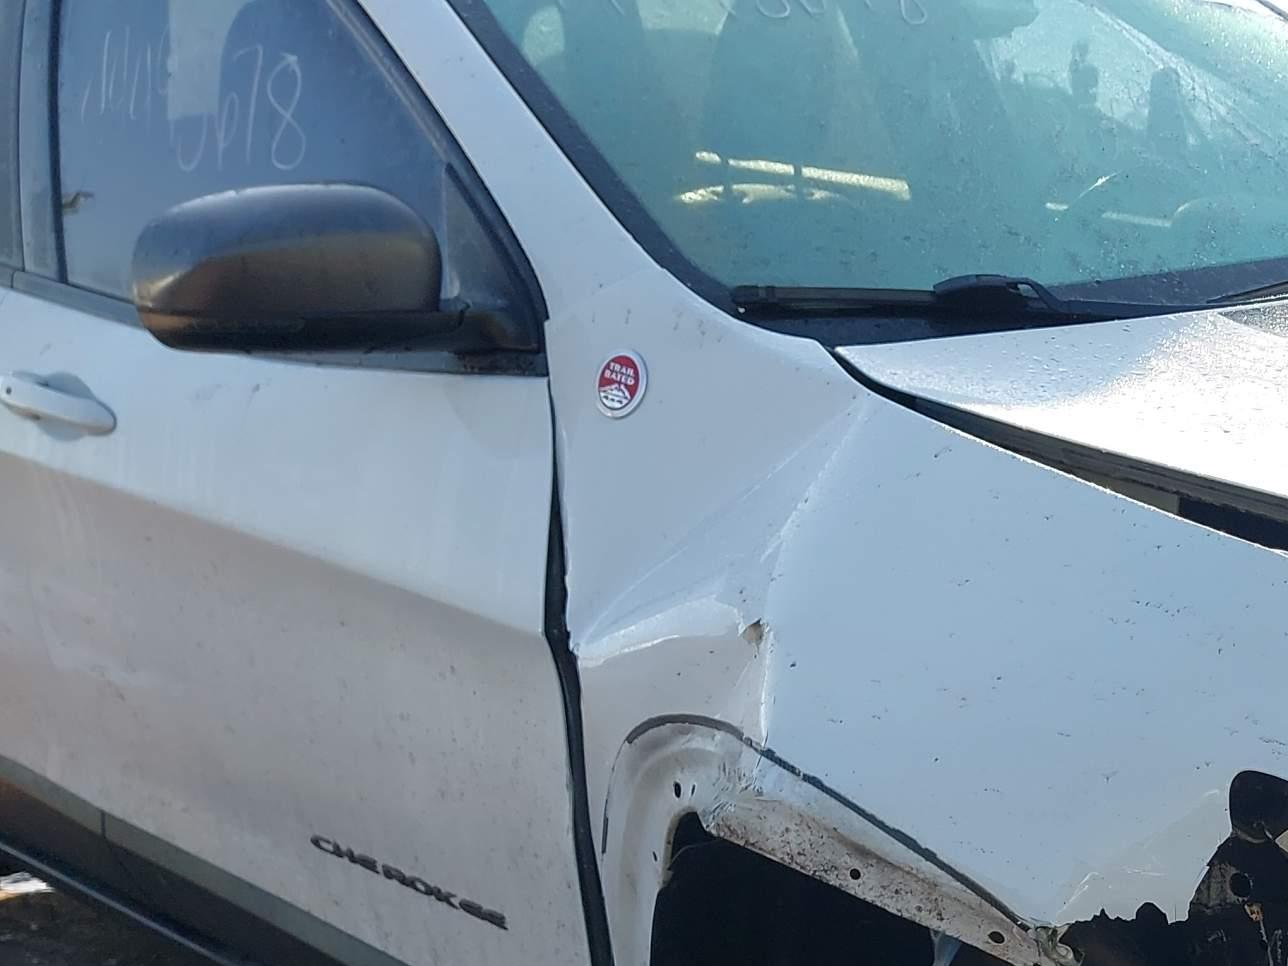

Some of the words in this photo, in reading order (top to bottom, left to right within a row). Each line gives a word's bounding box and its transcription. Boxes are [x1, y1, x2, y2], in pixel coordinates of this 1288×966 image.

[604, 369, 636, 386] RATED
[609, 362, 635, 377] TRAIL
[310, 834, 509, 930] CHEROKEE
